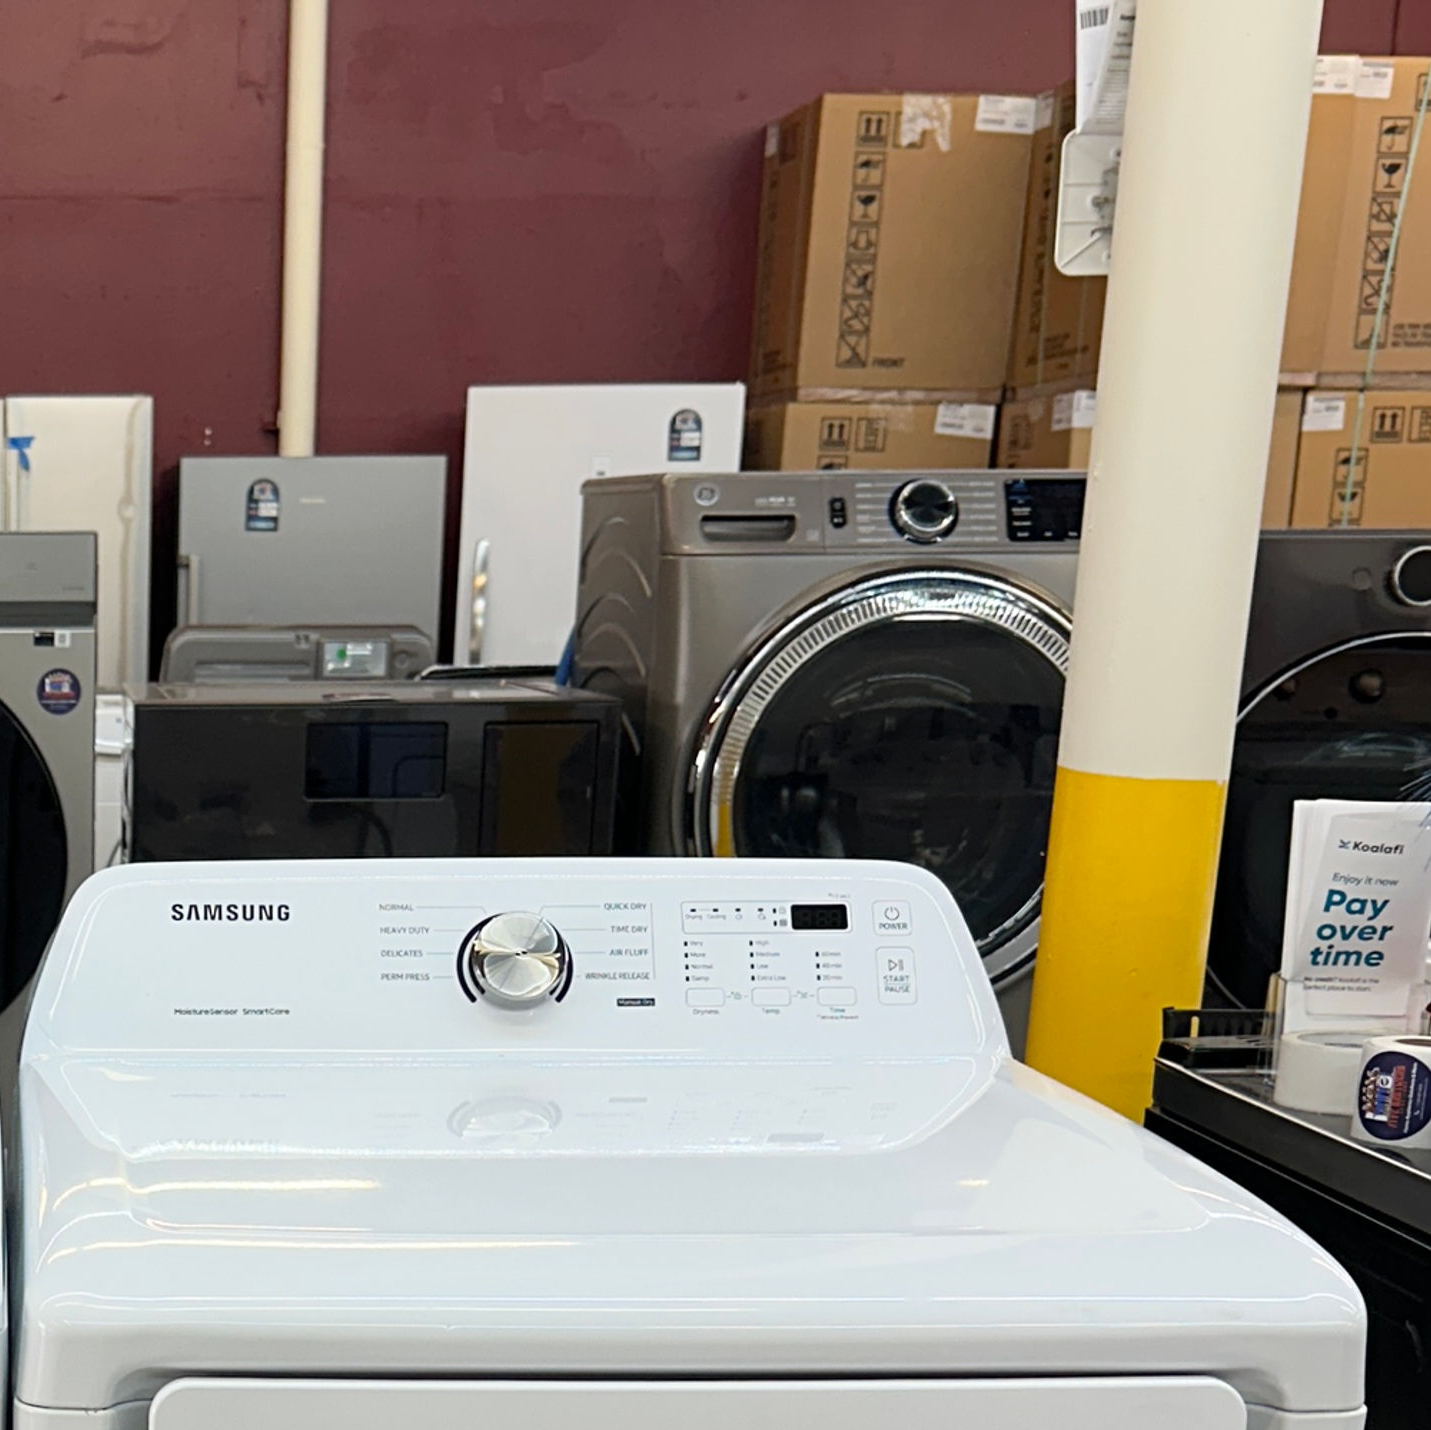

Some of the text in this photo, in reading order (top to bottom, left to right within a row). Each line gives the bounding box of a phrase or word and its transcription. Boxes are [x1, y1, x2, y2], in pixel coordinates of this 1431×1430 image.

[1352, 841, 1405, 855] Koalafi
[1332, 872, 1400, 887] Enjoy it now
[378, 903, 414, 912] NORMAL
[603, 902, 648, 911] QUICK DRY
[1323, 888, 1391, 922] Pay
[170, 903, 290, 921] SAMSUNG
[379, 926, 430, 935] HEAVY DUTY
[611, 925, 649, 934] TIME DRY
[878, 922, 908, 930] POWER
[1316, 923, 1394, 942] over
[379, 949, 424, 958] DELICATES
[609, 948, 649, 957] AIR FLUFF
[1310, 944, 1385, 968] time
[380, 972, 431, 982] PERM PRESS
[585, 971, 651, 981] WRINKLE RELEASE
[883, 974, 911, 983] START
[884, 985, 911, 994] PAUSE
[173, 1007, 291, 1017] MoistureSensor SmartCare
